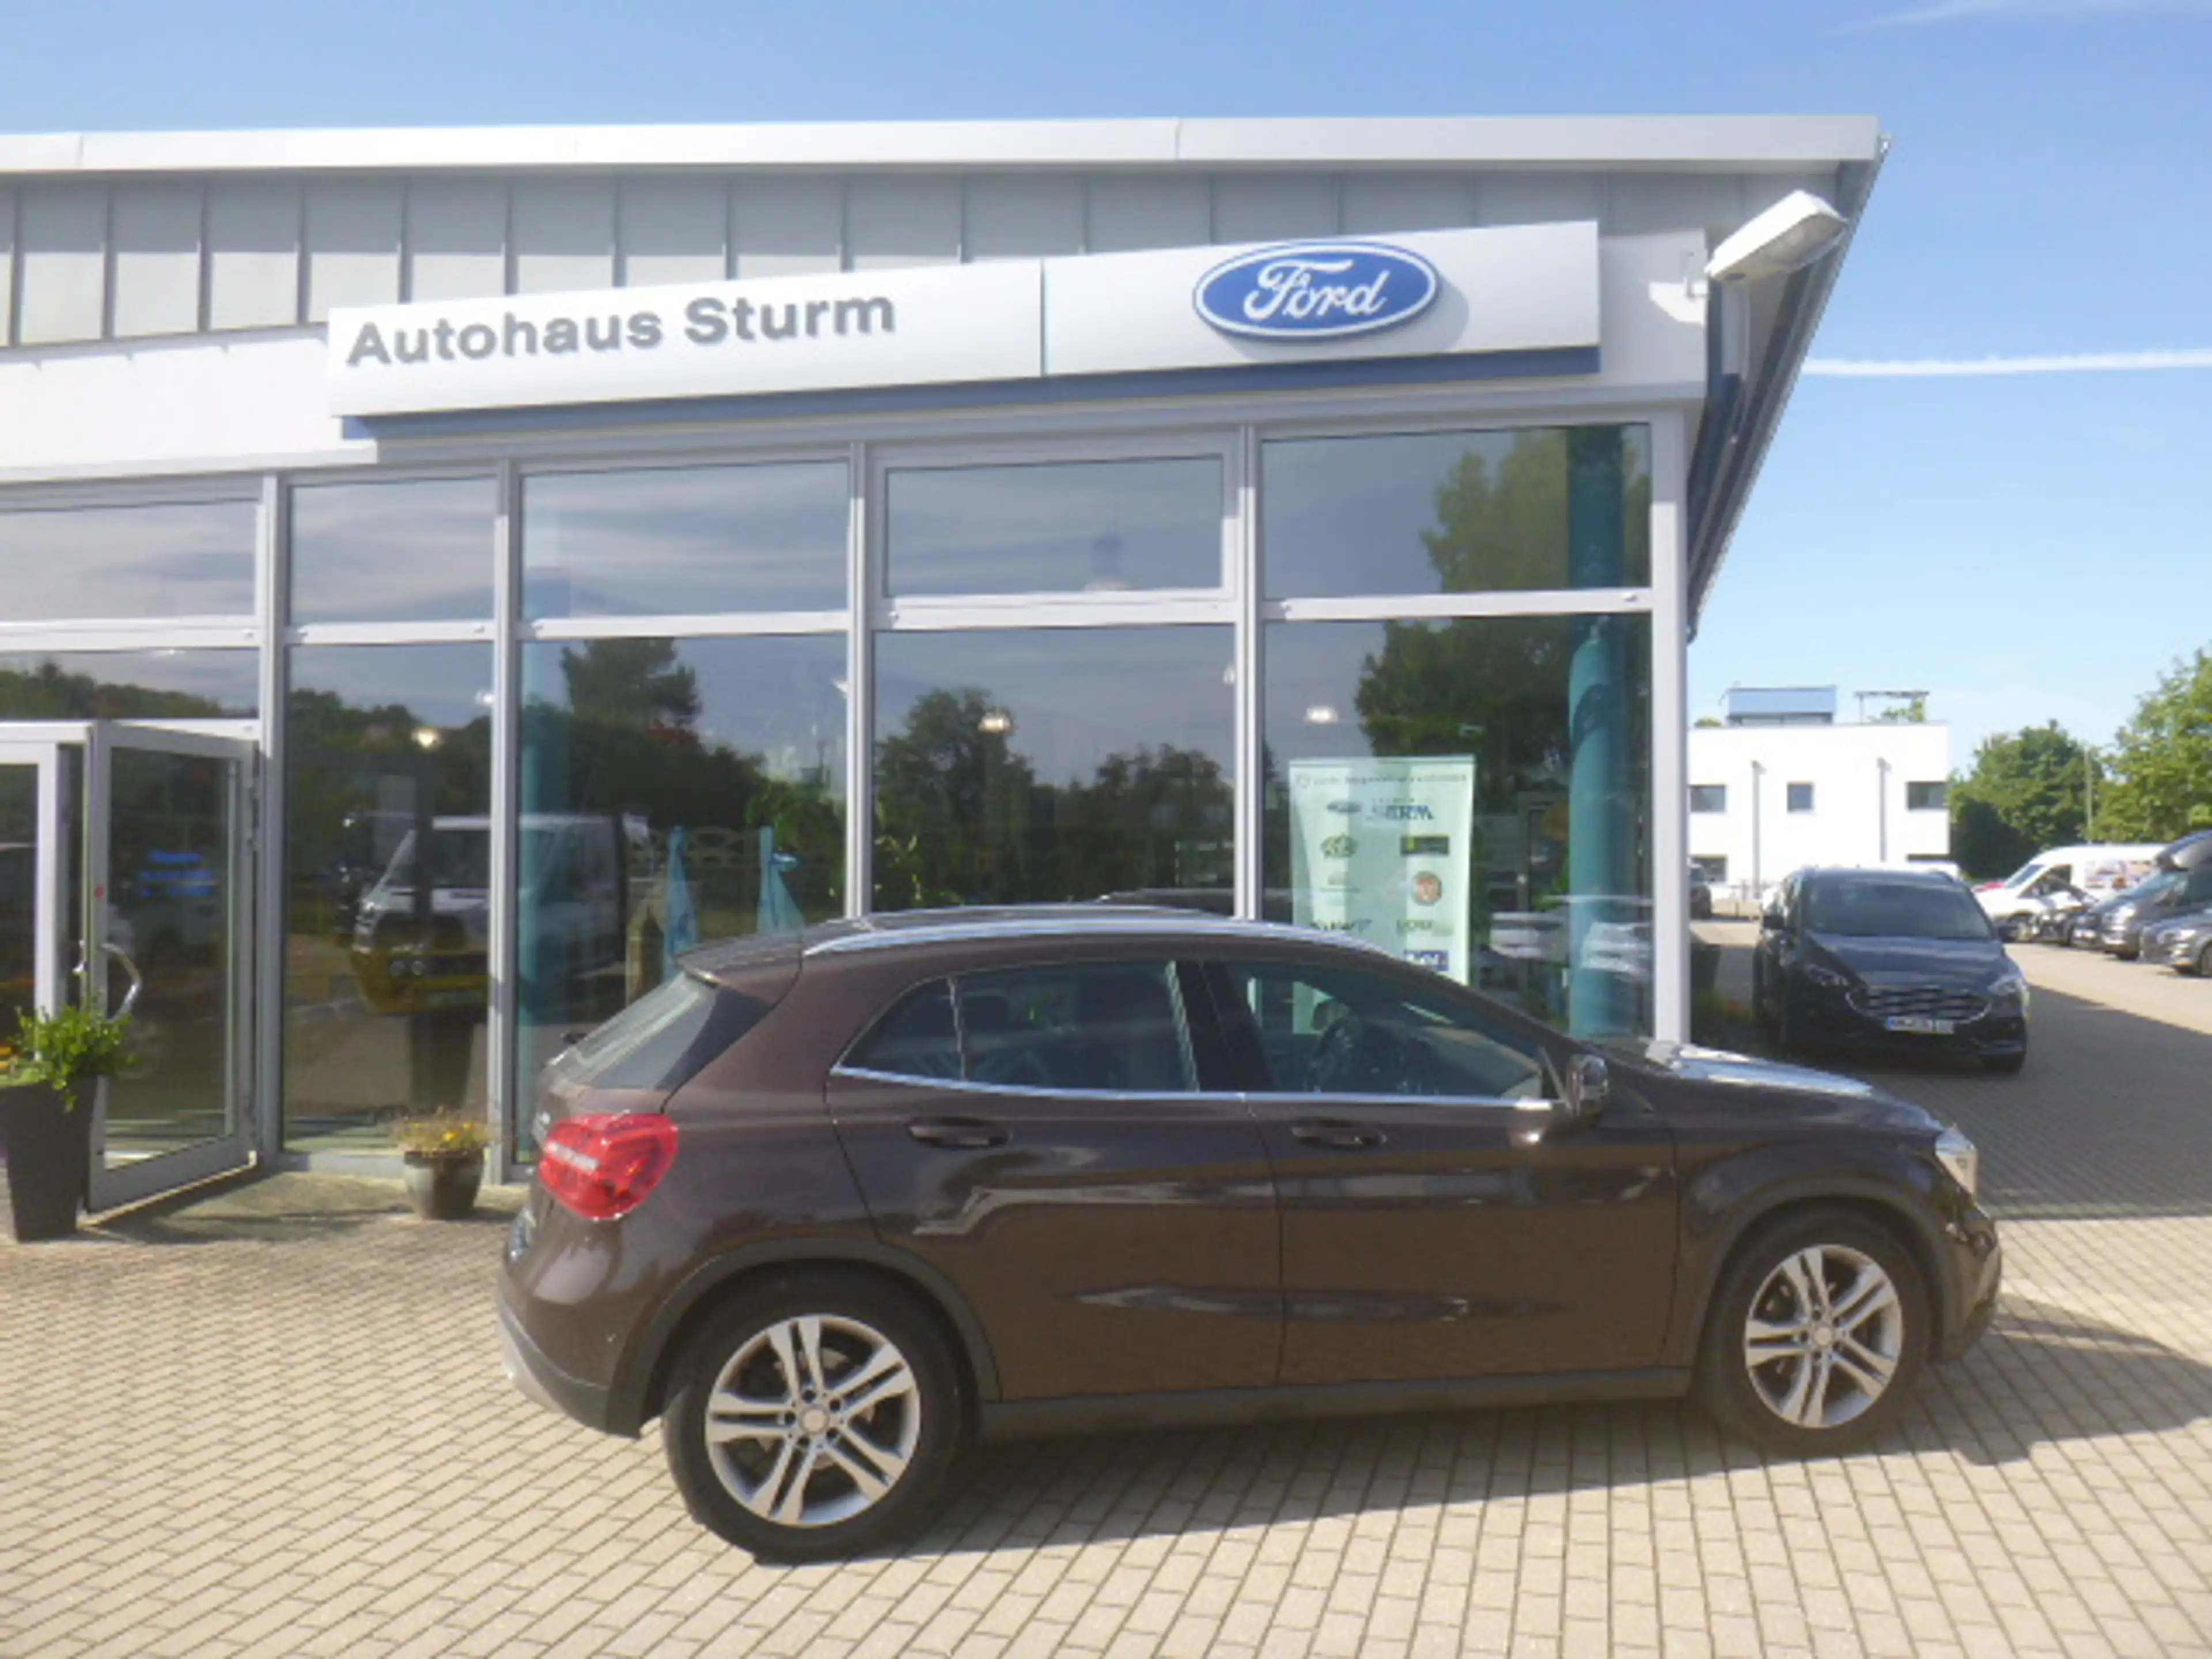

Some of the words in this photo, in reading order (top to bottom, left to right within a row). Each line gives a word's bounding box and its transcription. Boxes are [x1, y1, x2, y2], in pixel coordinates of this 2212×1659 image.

[1243, 258, 1391, 320] Ford
[347, 311, 662, 367] Autohaus
[685, 296, 896, 343] Sturm
